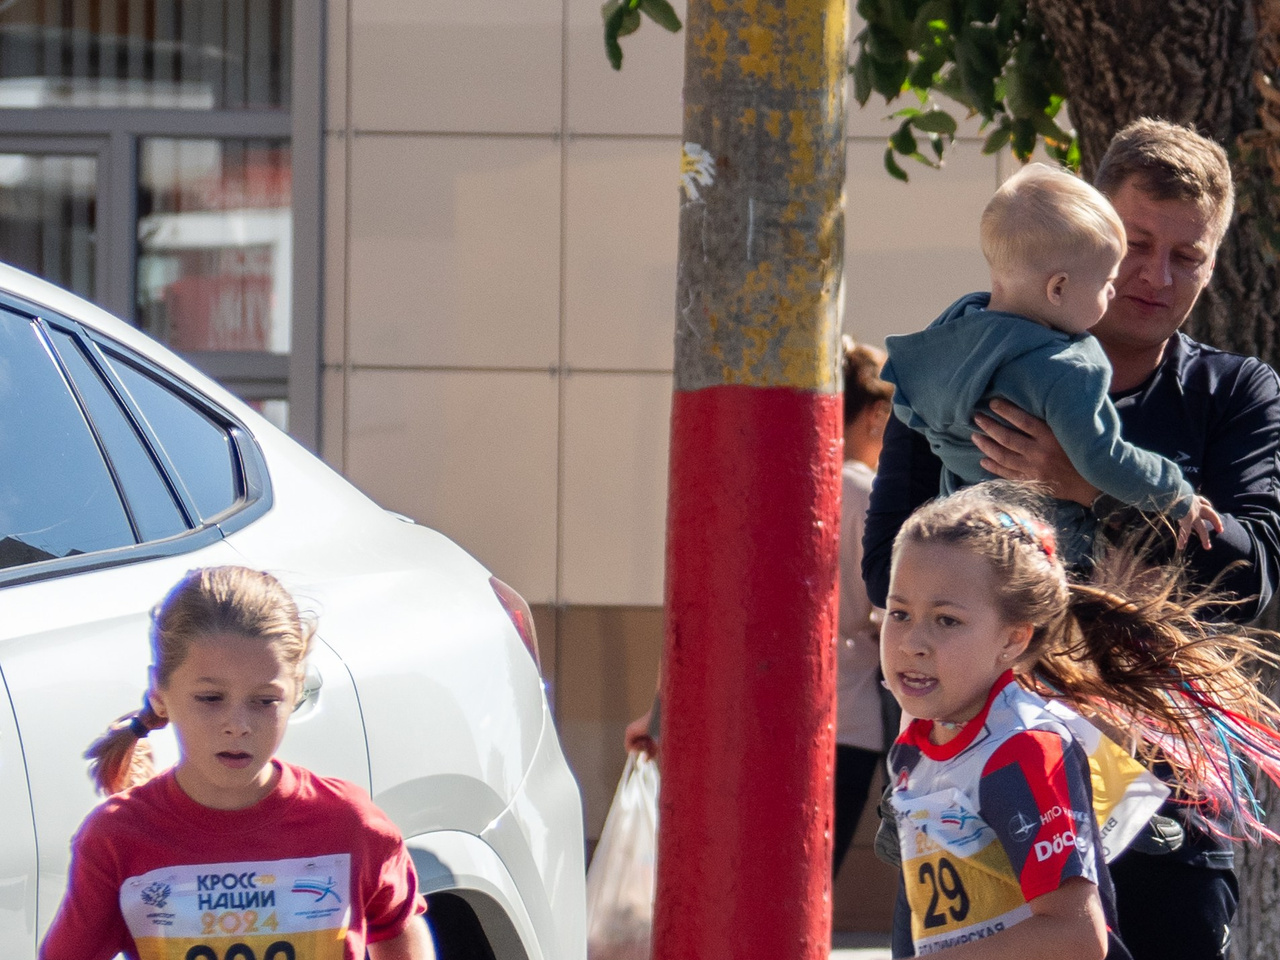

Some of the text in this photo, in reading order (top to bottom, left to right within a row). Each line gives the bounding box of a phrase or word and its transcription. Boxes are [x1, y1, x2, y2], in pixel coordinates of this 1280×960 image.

[1182, 465, 1200, 473] MIX
[1040, 806, 1062, 826] НПО
[1034, 831, 1089, 862] Döce
[197, 872, 256, 891] КРОСС
[198, 891, 275, 910] НАЦИИ
[919, 857, 970, 929] 29
[201, 911, 279, 935] 2024
